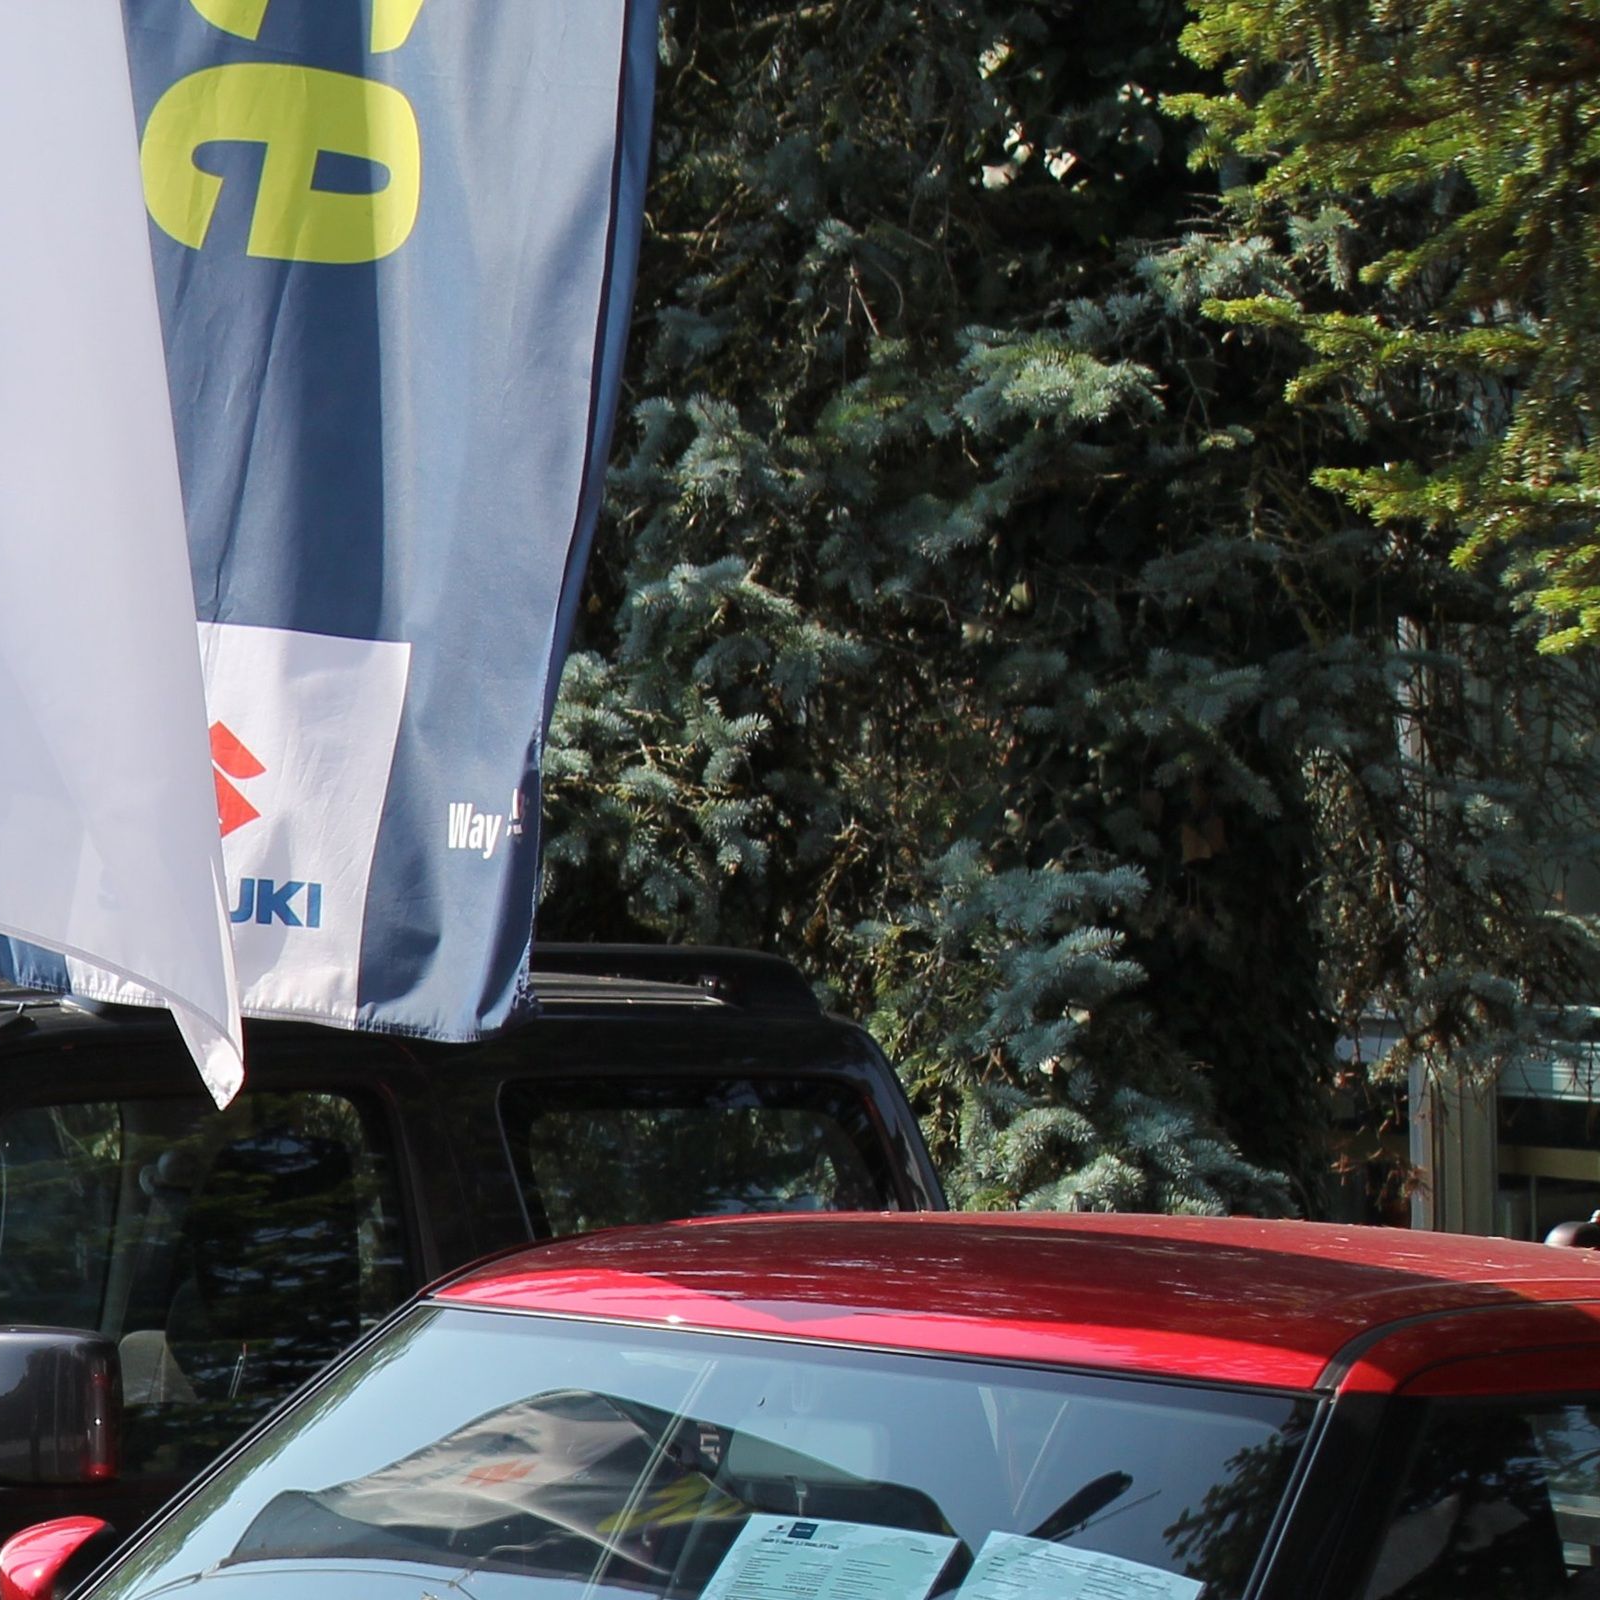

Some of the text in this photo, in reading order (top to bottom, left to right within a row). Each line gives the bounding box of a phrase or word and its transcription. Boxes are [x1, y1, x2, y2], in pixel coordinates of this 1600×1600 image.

[141, 0, 423, 264] e
[448, 802, 502, 859] Way
[229, 877, 323, 929] UKI
